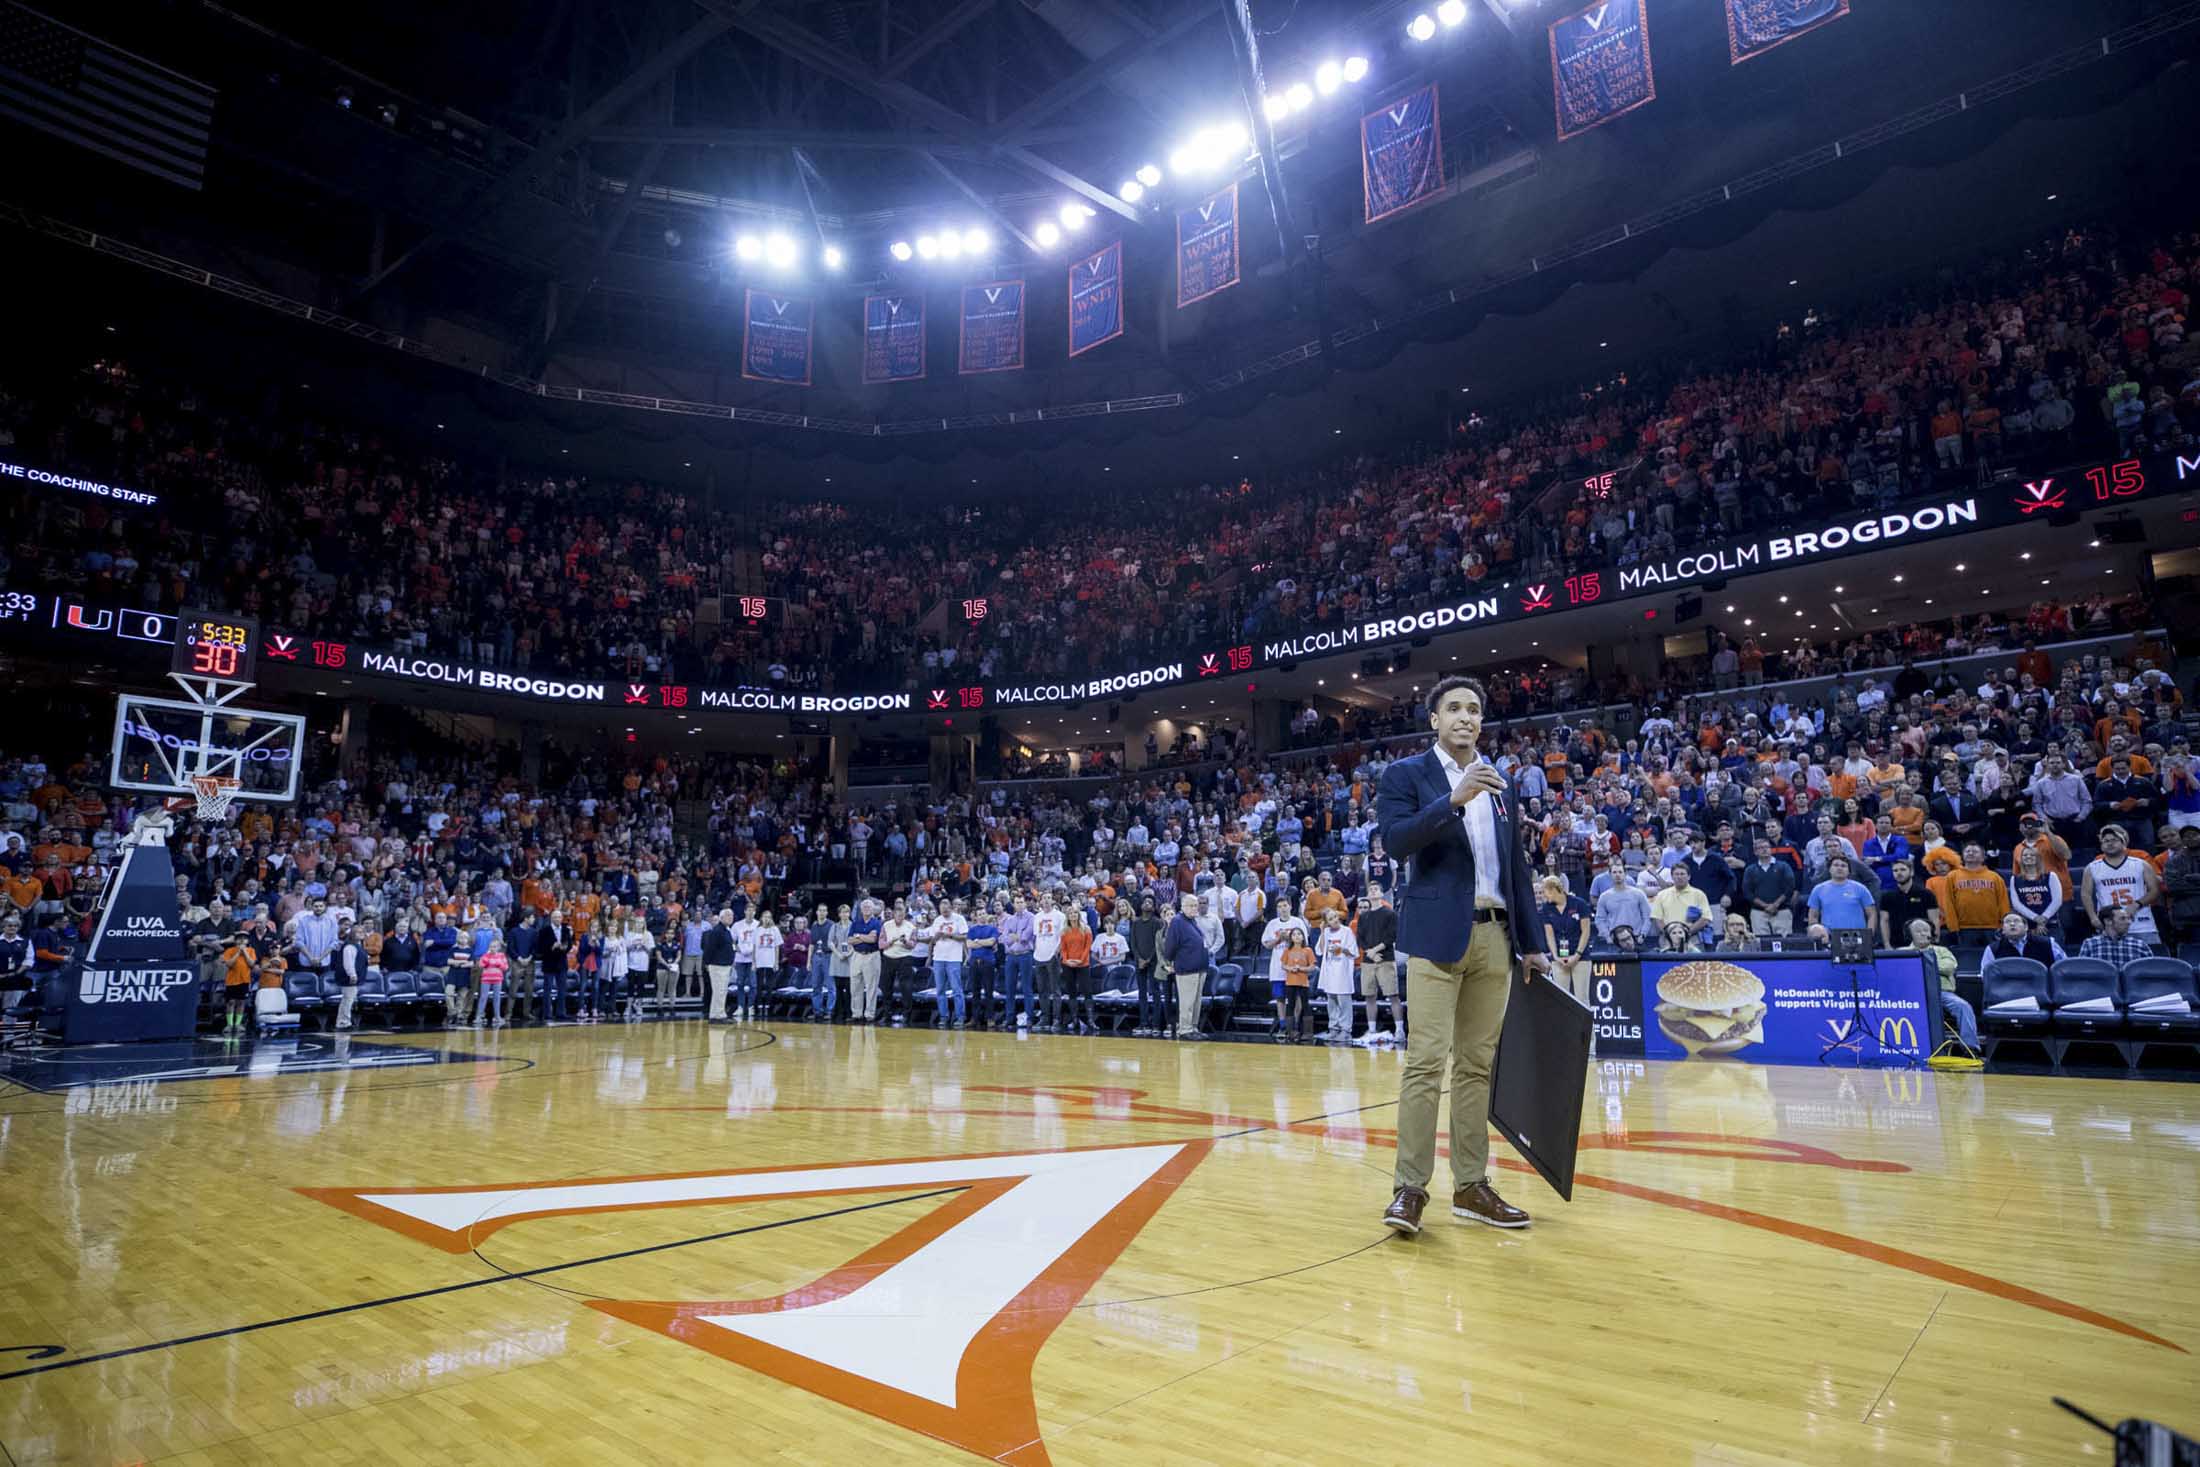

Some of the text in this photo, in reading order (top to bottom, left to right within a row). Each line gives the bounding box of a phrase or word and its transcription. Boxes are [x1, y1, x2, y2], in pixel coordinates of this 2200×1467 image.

[27, 469, 110, 495] COACHING
[111, 487, 158, 505] STAFF
[2085, 460, 2145, 499] 15
[1564, 573, 1602, 603] 15
[1619, 544, 1760, 591] MALCOLM
[1768, 499, 1978, 561] BROGDON
[740, 598, 766, 617] 15
[963, 600, 988, 618] 15
[143, 616, 162, 638] 0
[203, 622, 246, 645] 5:33
[1227, 646, 1253, 670] 15
[1264, 627, 1358, 661] MALCOLM
[1363, 598, 1498, 641] BROGDON
[193, 640, 237, 675] 30
[312, 641, 348, 668] 15
[362, 652, 474, 685] MALCOLM
[479, 671, 604, 700] BROGDON
[958, 687, 983, 707] 15
[996, 683, 1085, 703] MALCOLM
[1088, 664, 1183, 697] BROGDON
[659, 686, 688, 707] 15
[701, 691, 796, 710] MALCOLM
[801, 694, 910, 711] BROGDON
[1957, 878, 1995, 889] VIRGINIA
[2019, 886, 2049, 894] VIRGINIA
[2101, 876, 2137, 886] VIRGINIA
[2026, 893, 2044, 905] 32
[2111, 888, 2134, 906] 15
[127, 916, 166, 929] UVA
[106, 929, 180, 937] ORTHOPEDICS
[107, 969, 193, 987] UNITED
[105, 985, 170, 1003] BANK
[1596, 979, 1613, 1003] 0
[1774, 988, 1835, 998] McDonald's
[1775, 999, 1920, 1010] supports Virgina Athletics
[1593, 1024, 1642, 1039] FOULS
